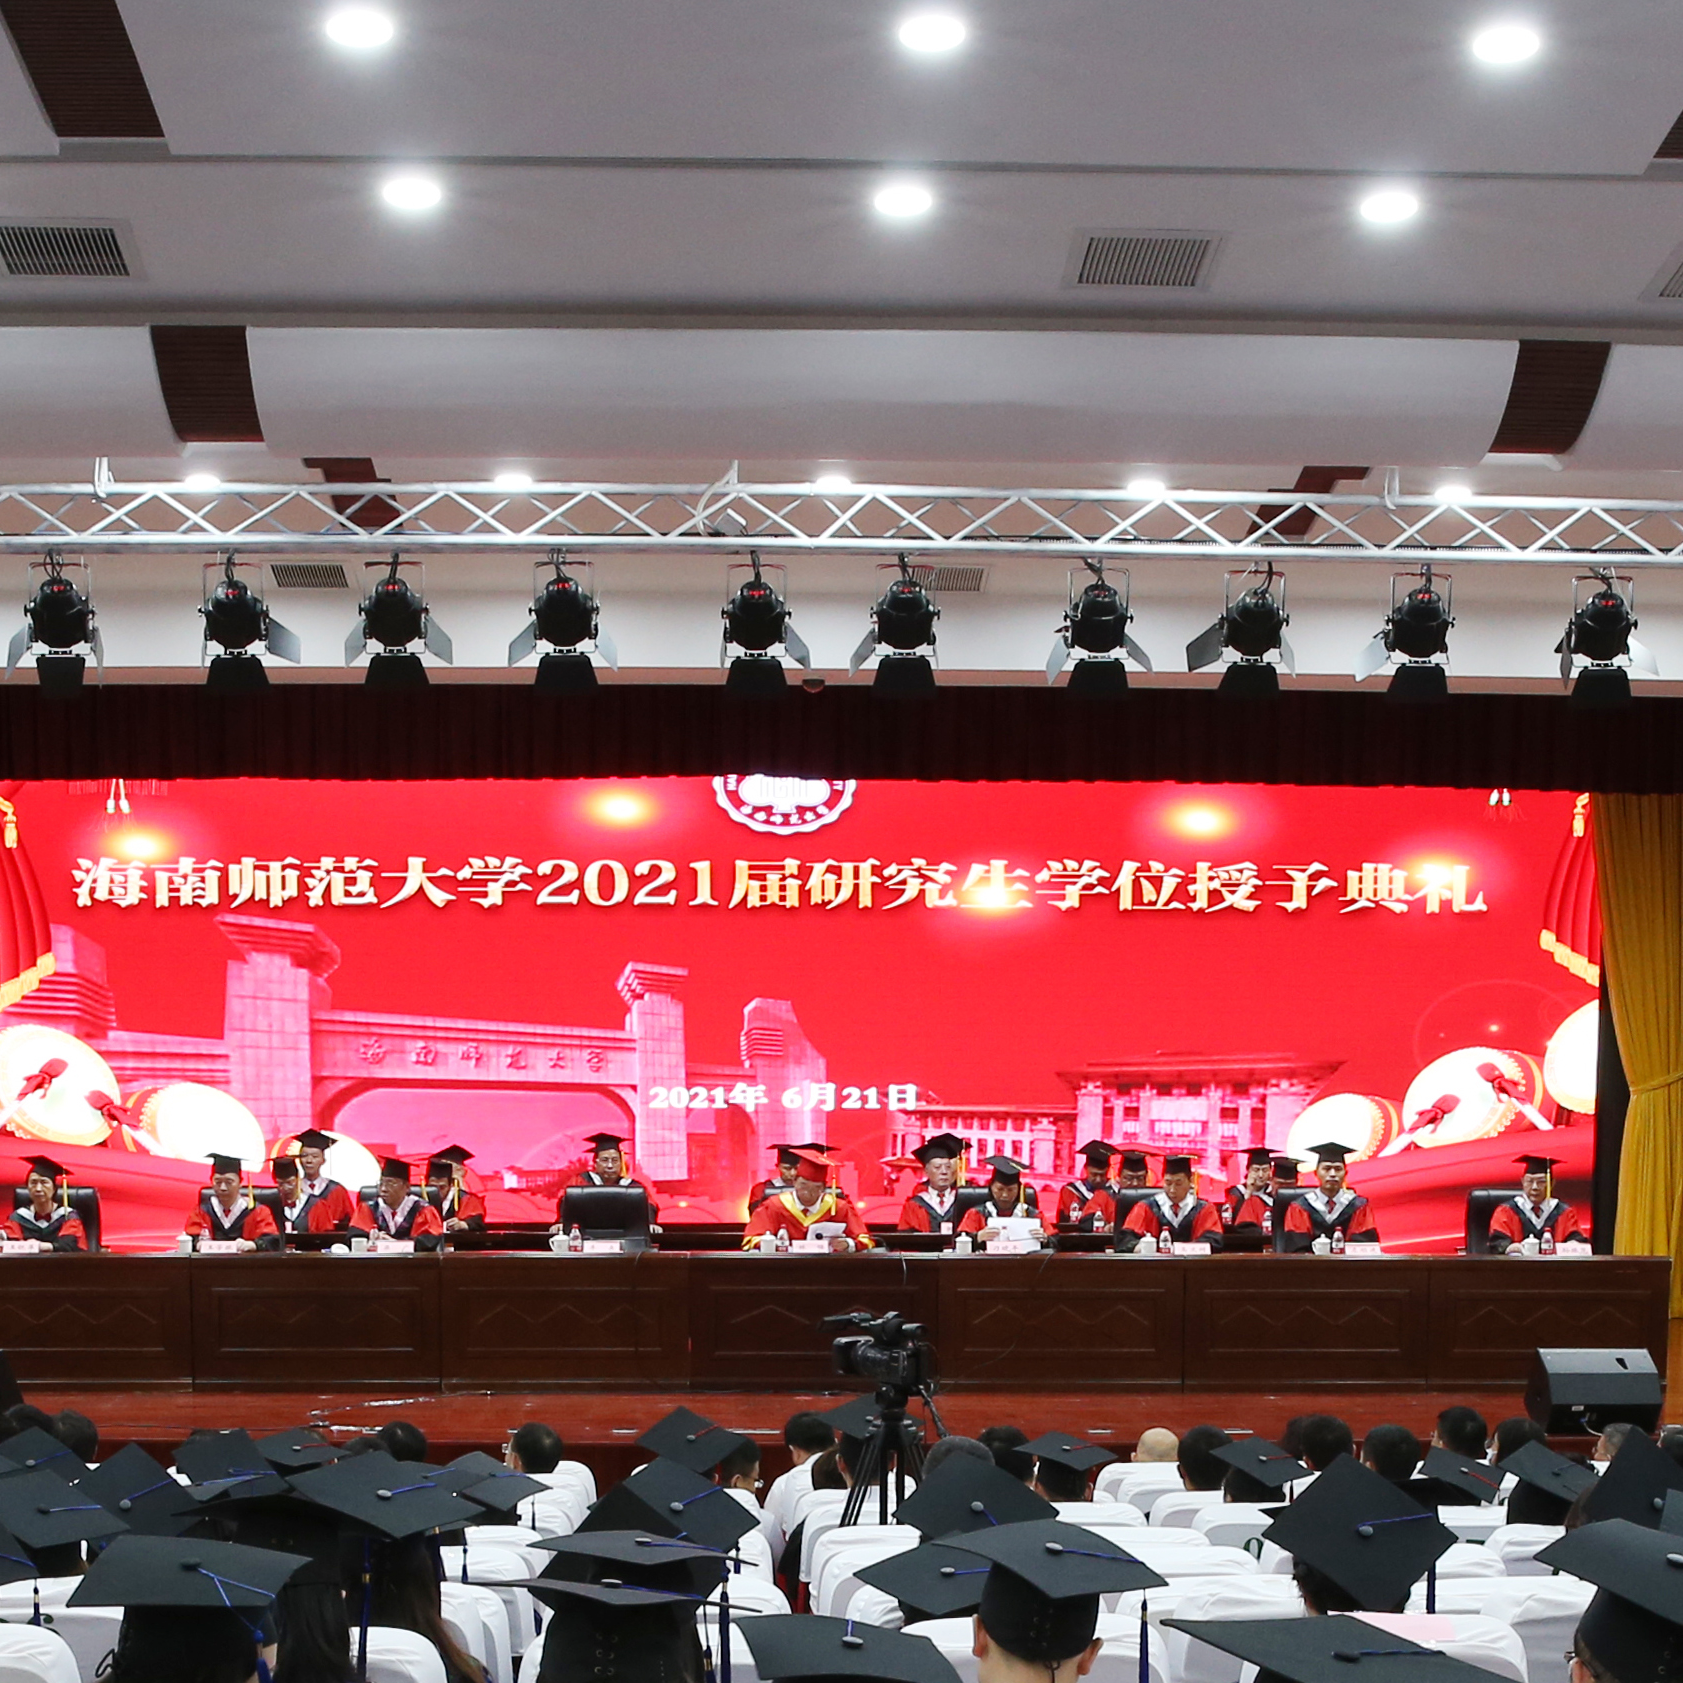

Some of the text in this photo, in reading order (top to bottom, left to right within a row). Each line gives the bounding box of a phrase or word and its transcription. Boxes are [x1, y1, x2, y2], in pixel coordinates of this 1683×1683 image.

[71, 856, 1489, 914] 海南师范大学2021届研究生学位授予典礼
[648, 1081, 918, 1113] 2021年 6月21日
